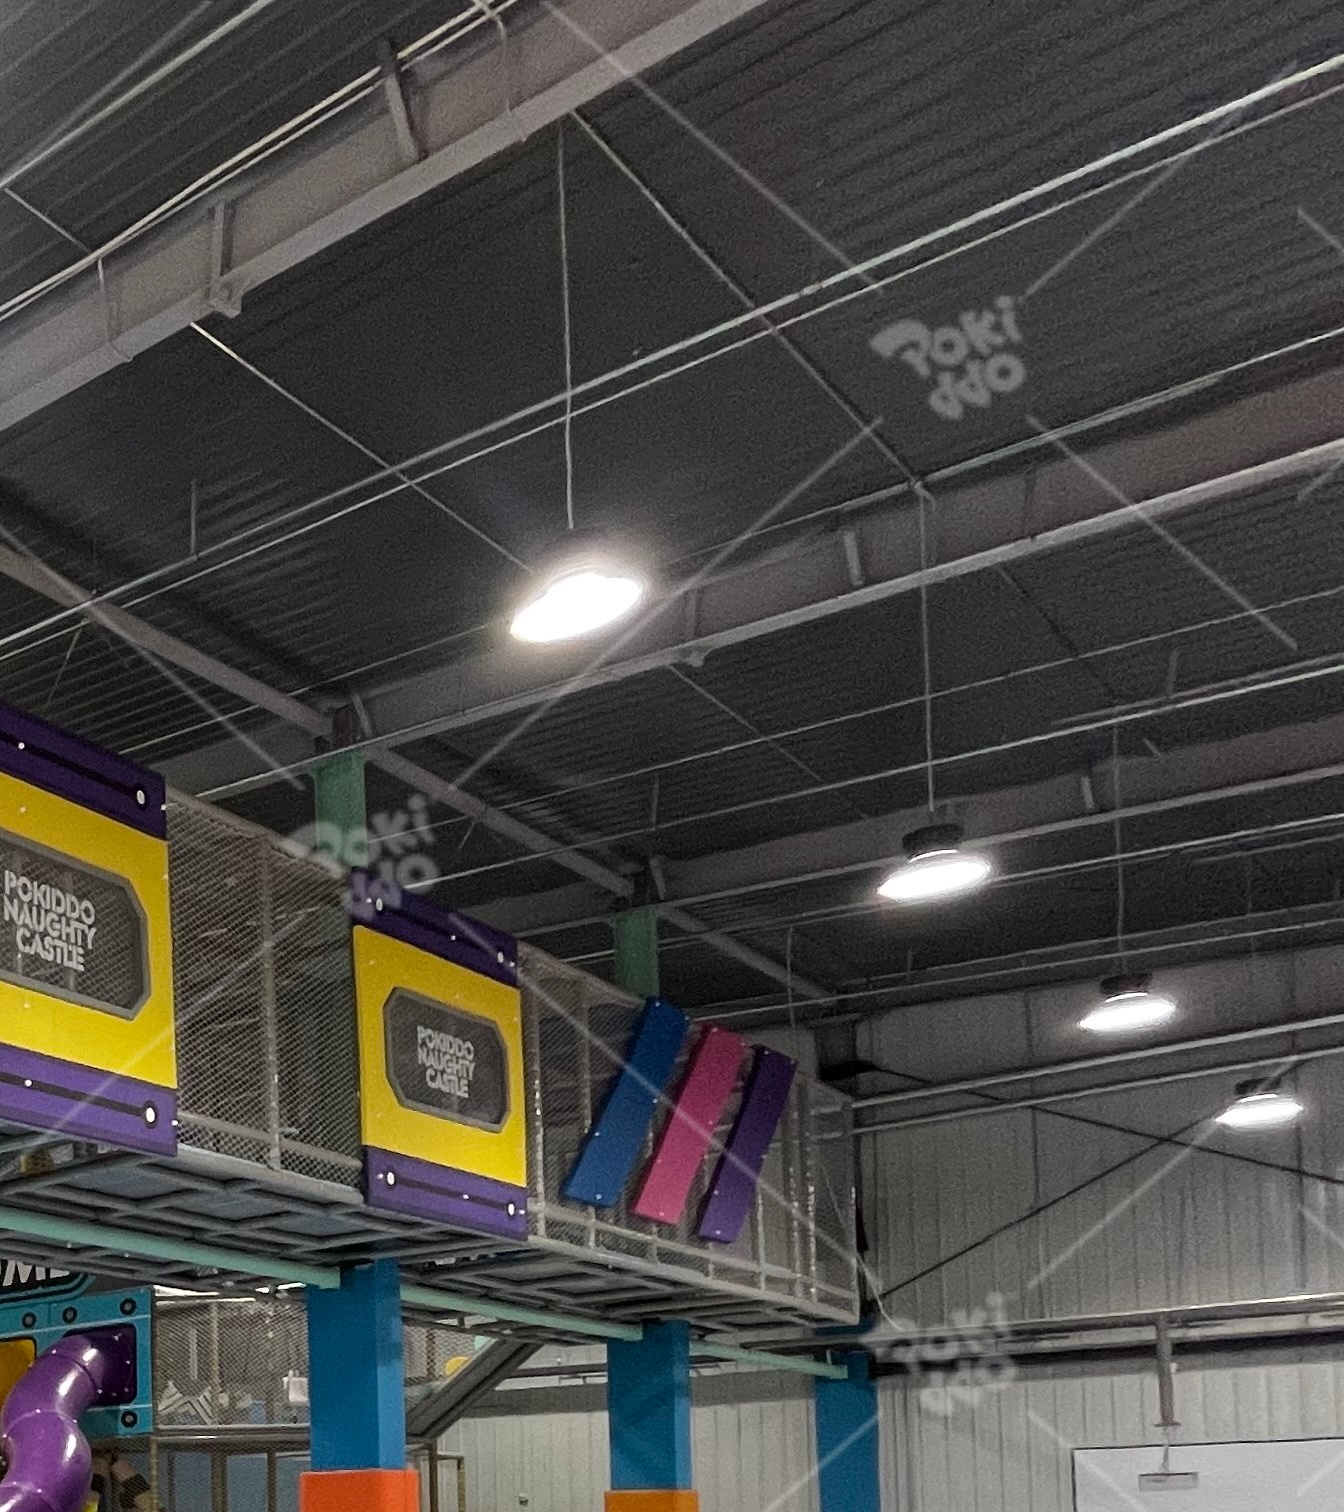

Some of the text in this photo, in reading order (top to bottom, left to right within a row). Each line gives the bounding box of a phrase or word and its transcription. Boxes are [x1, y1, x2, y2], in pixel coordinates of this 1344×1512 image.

[4, 870, 95, 925] POKIDDO
[3, 894, 96, 950] NAUGHTY
[16, 927, 84, 972] CASTLE
[417, 1024, 474, 1060] POKIDDO
[417, 1043, 476, 1081] NAUGHTY
[426, 1067, 468, 1098] CASTLE
